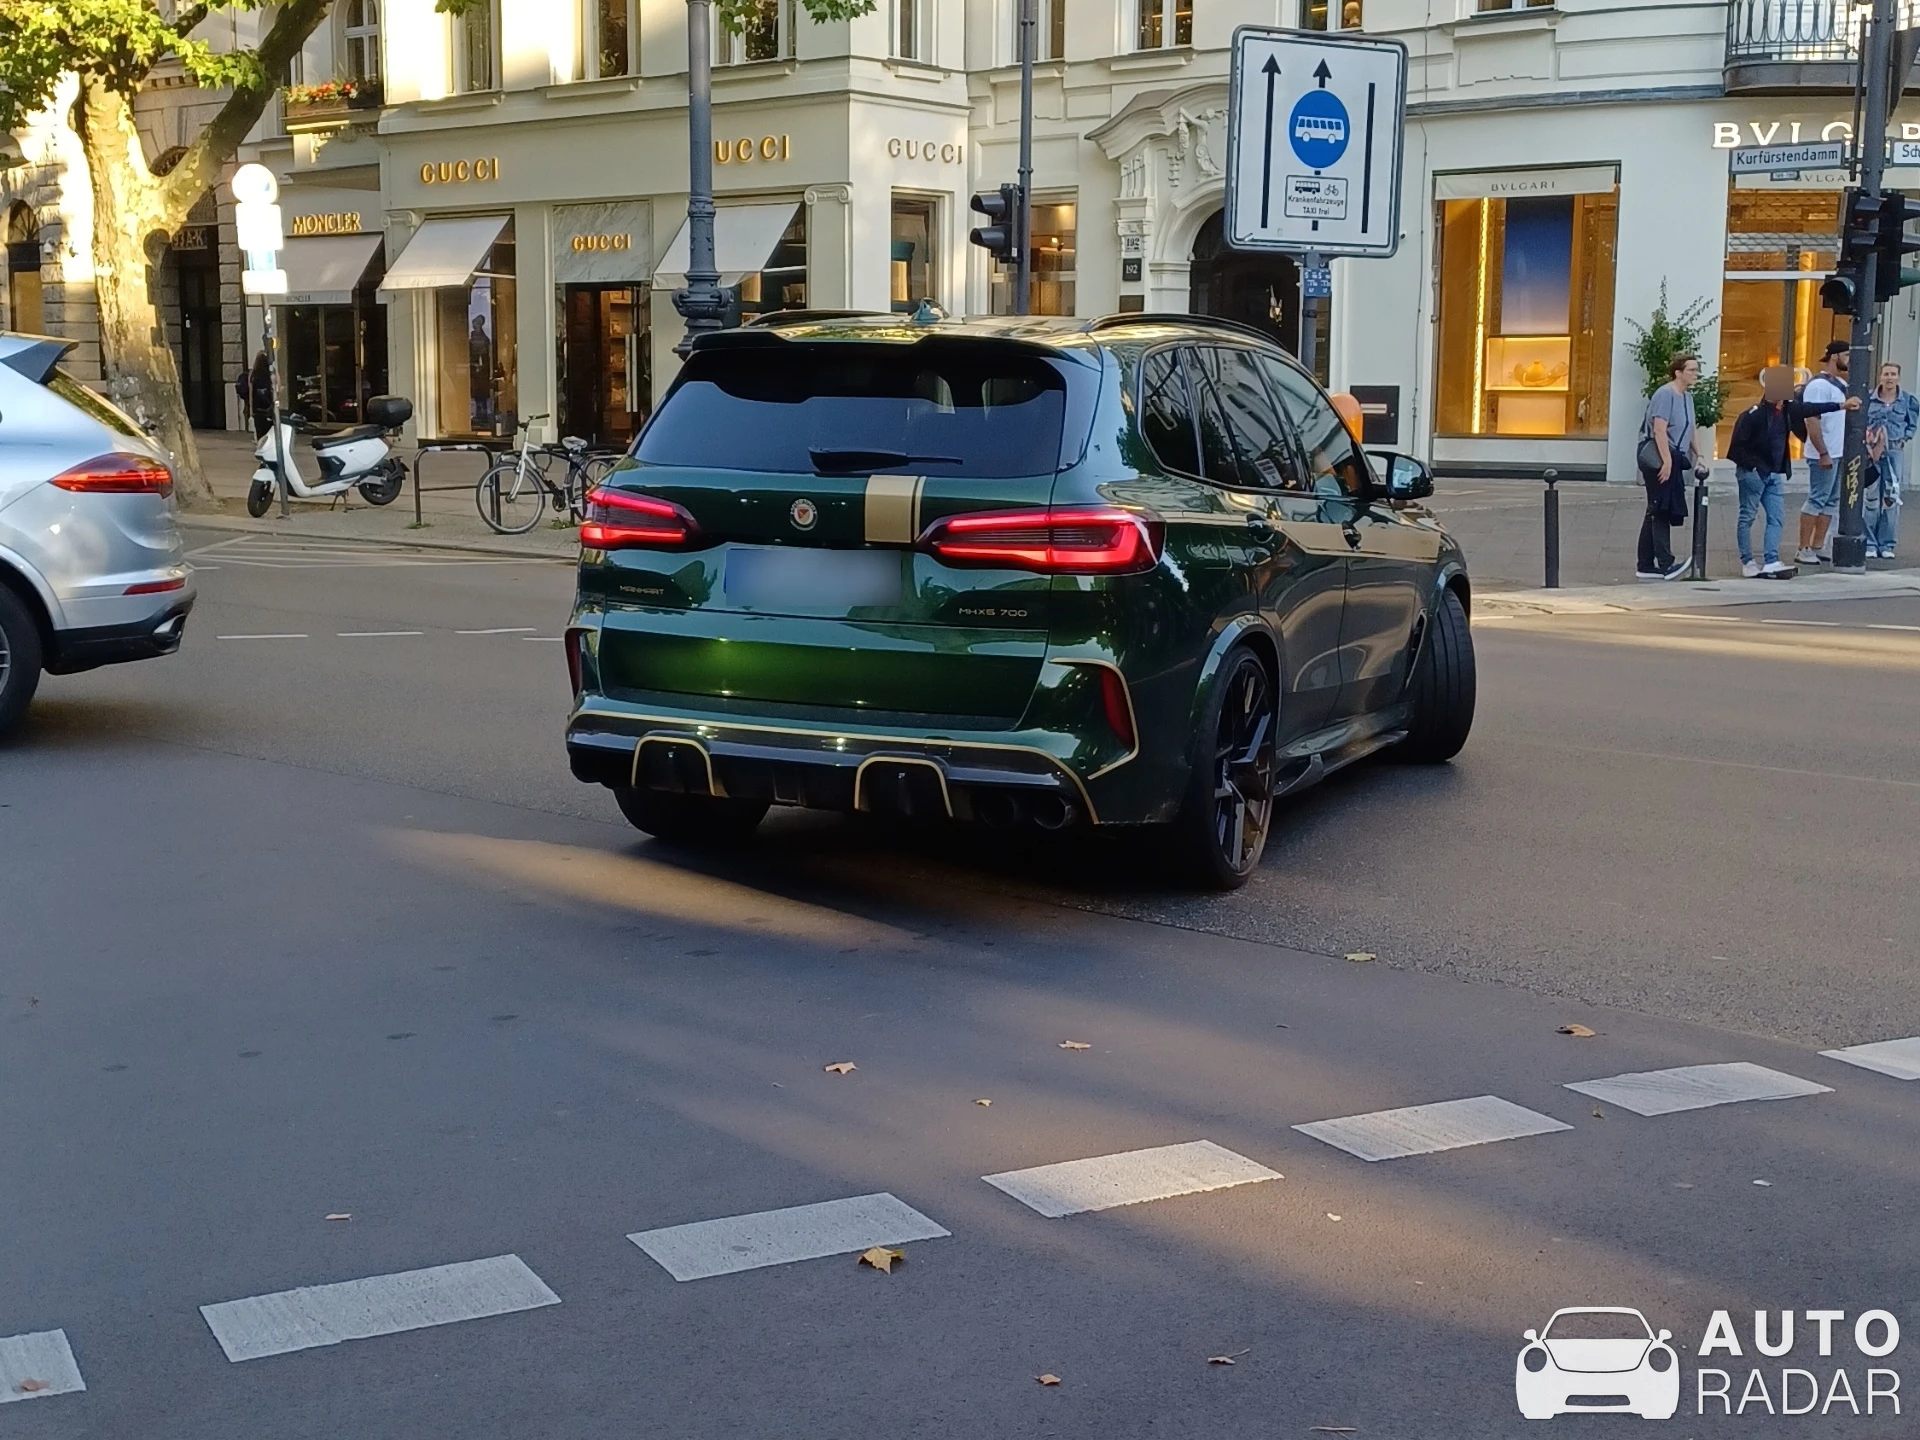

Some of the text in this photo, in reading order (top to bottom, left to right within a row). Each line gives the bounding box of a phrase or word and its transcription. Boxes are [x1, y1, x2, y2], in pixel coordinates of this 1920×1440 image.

[714, 133, 791, 164] UCCI
[888, 137, 963, 165] GUCCI
[1736, 148, 1839, 166] Kurfürstendamm
[420, 156, 499, 184] GUCCI
[1491, 181, 1555, 191] BVLGARI
[1288, 195, 1344, 206] Krankenfahrzeuge
[1302, 206, 1317, 214] TAXI
[292, 212, 362, 234] MONCLER
[571, 233, 632, 251] GUCCI
[1125, 264, 1138, 274] 192
[1000, 609, 1028, 617] 700
